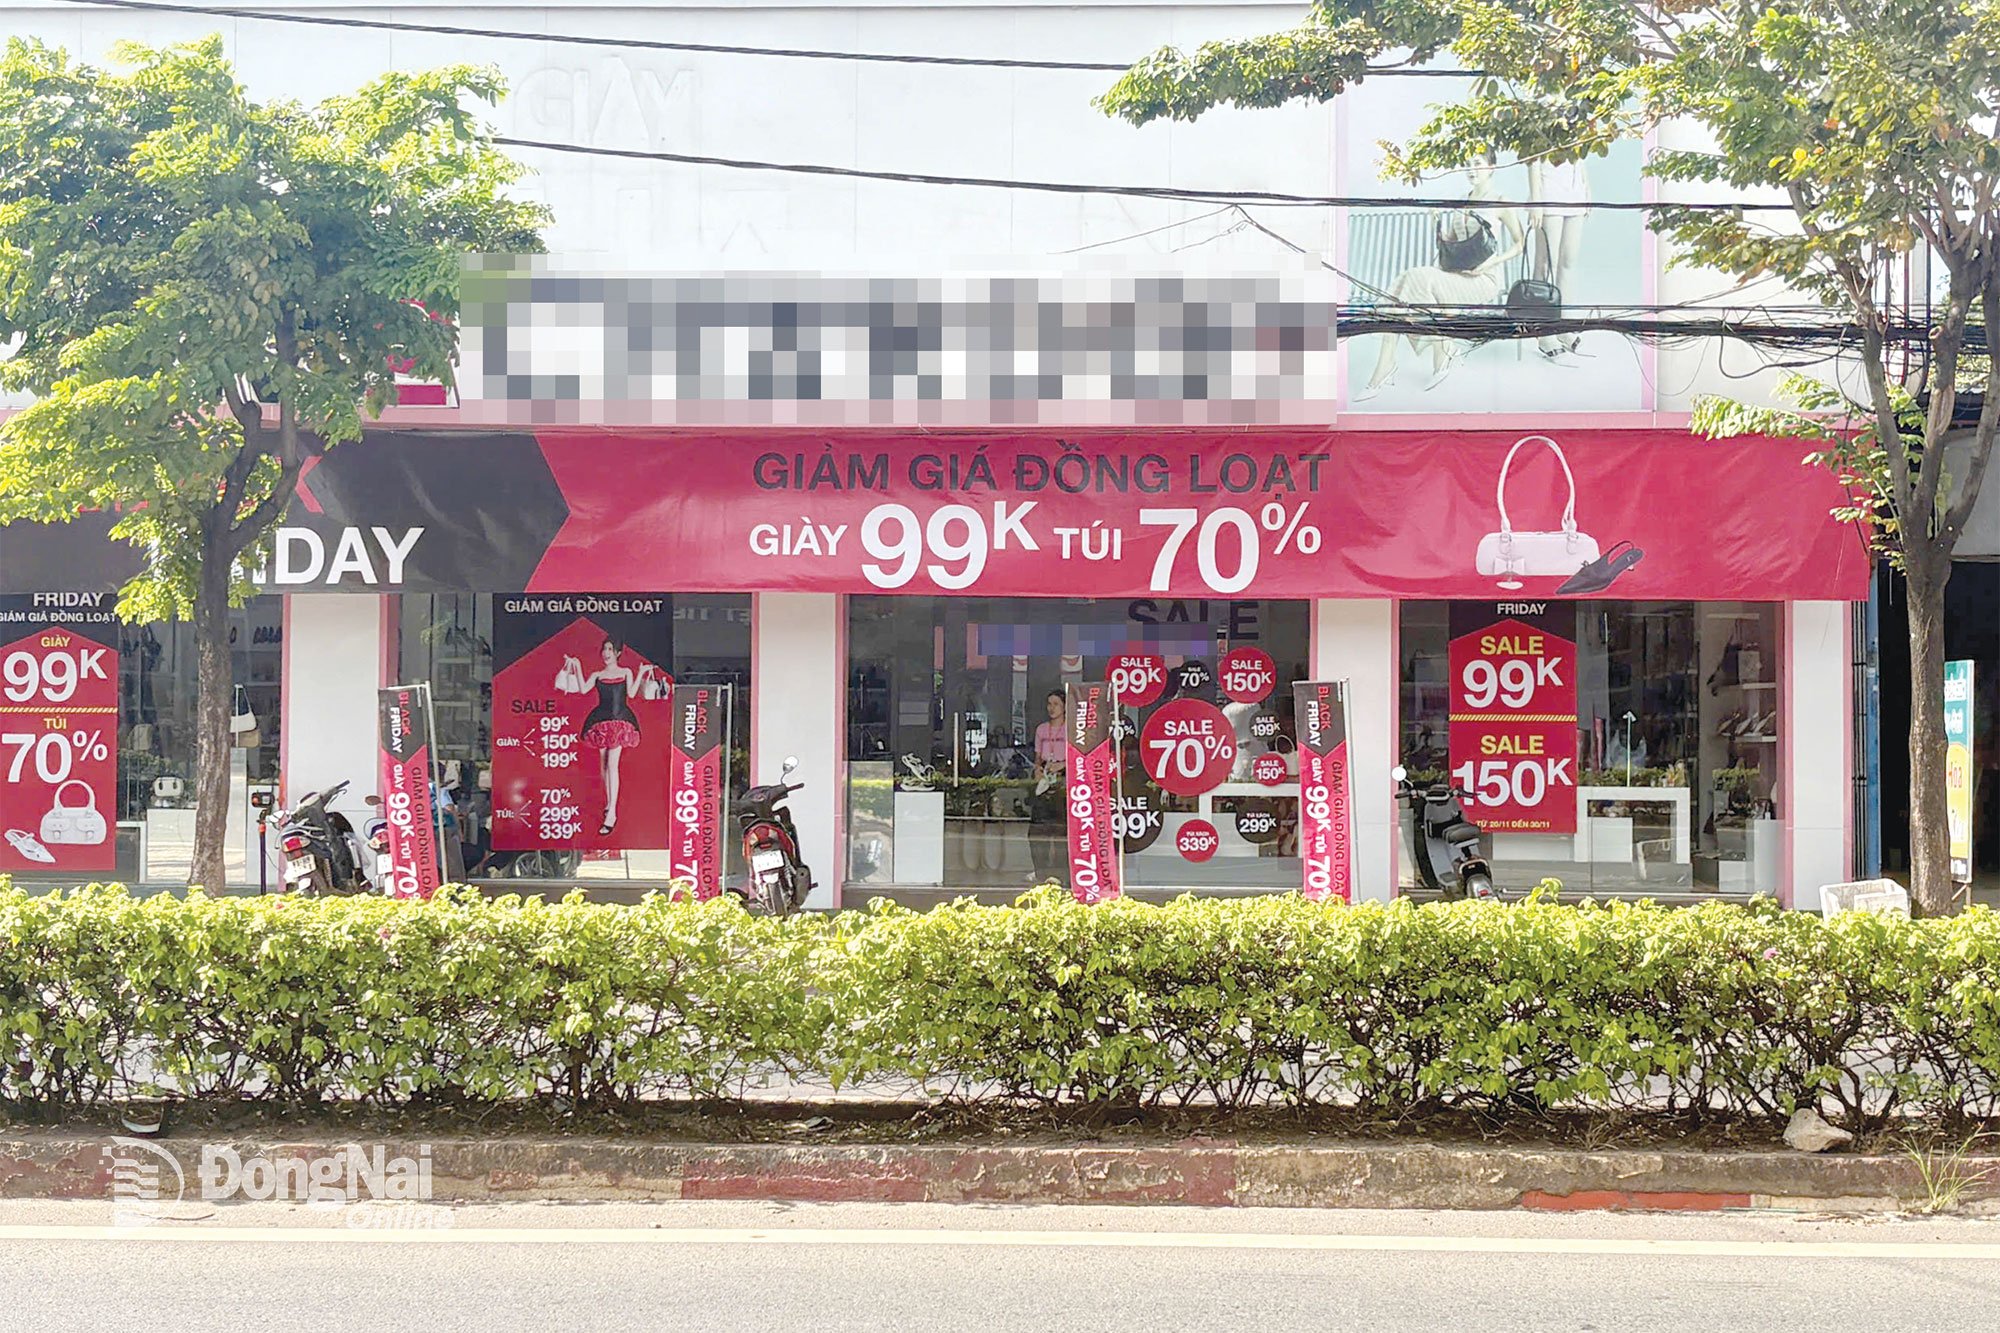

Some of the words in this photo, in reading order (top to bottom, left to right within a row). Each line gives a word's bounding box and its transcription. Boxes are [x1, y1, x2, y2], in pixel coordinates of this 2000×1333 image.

[753, 441, 890, 491] GIẢM
[908, 445, 992, 491] GIÁ
[1014, 439, 1171, 493] ĐỒNG
[1189, 452, 1330, 500] LOẠT
[749, 516, 847, 556] GIÀY
[860, 501, 1039, 589] 99K
[1053, 519, 1121, 560] TÚI
[1138, 501, 1322, 593] 70%
[33, 592, 104, 607] FRIDAY
[547, 597, 573, 612] GIÁ
[576, 595, 619, 612] ĐỒNG
[623, 599, 663, 614] LOẠT
[1496, 603, 1547, 615] FRIDAY
[28, 610, 48, 622] GIÁ
[50, 608, 84, 622] ĐỒNG
[41, 634, 71, 647] GIÀY
[1480, 636, 1544, 655] SALE
[1120, 657, 1152, 668] SALE
[1231, 660, 1263, 671] SALE
[3, 649, 108, 702] 99K
[1111, 667, 1162, 694] 99K
[1180, 672, 1210, 687] 70%
[1222, 672, 1272, 693] 150K
[1463, 657, 1564, 709] 99K
[398, 692, 411, 736] BLACK
[512, 700, 556, 714] SALE
[697, 690, 708, 734] BLACK
[1087, 688, 1100, 729] BLACK
[1318, 687, 1331, 730] BLACK
[43, 716, 68, 729] TÚI
[390, 707, 403, 753] FRIDAY
[540, 716, 570, 732] 99K
[684, 704, 697, 751] FRIDAY
[1076, 701, 1088, 746] FRIDAY
[1164, 720, 1213, 737] SALE
[1251, 722, 1281, 736] 199K
[1255, 716, 1275, 724] SALE
[1307, 701, 1321, 747] FRIDAY
[540, 733, 578, 750] 150K
[1480, 735, 1544, 755] SALE
[1, 730, 108, 784] 70%
[540, 752, 578, 768] 199K
[1150, 734, 1233, 779] 70%
[1256, 766, 1285, 780] 150K
[1452, 758, 1573, 807] 150K
[540, 788, 571, 804] 70%
[1109, 797, 1149, 810] SALE
[388, 792, 415, 838] 99K
[540, 806, 579, 822] 299K
[675, 790, 700, 836] 99K
[1070, 784, 1095, 831] 99K
[1305, 785, 1332, 833] 99K
[539, 823, 582, 839] 339K
[1111, 811, 1161, 839] 99K
[1239, 818, 1277, 833] 299K
[1180, 837, 1216, 851] 339K
[421, 868, 433, 898] LOẠ
[1074, 854, 1100, 901] 70%
